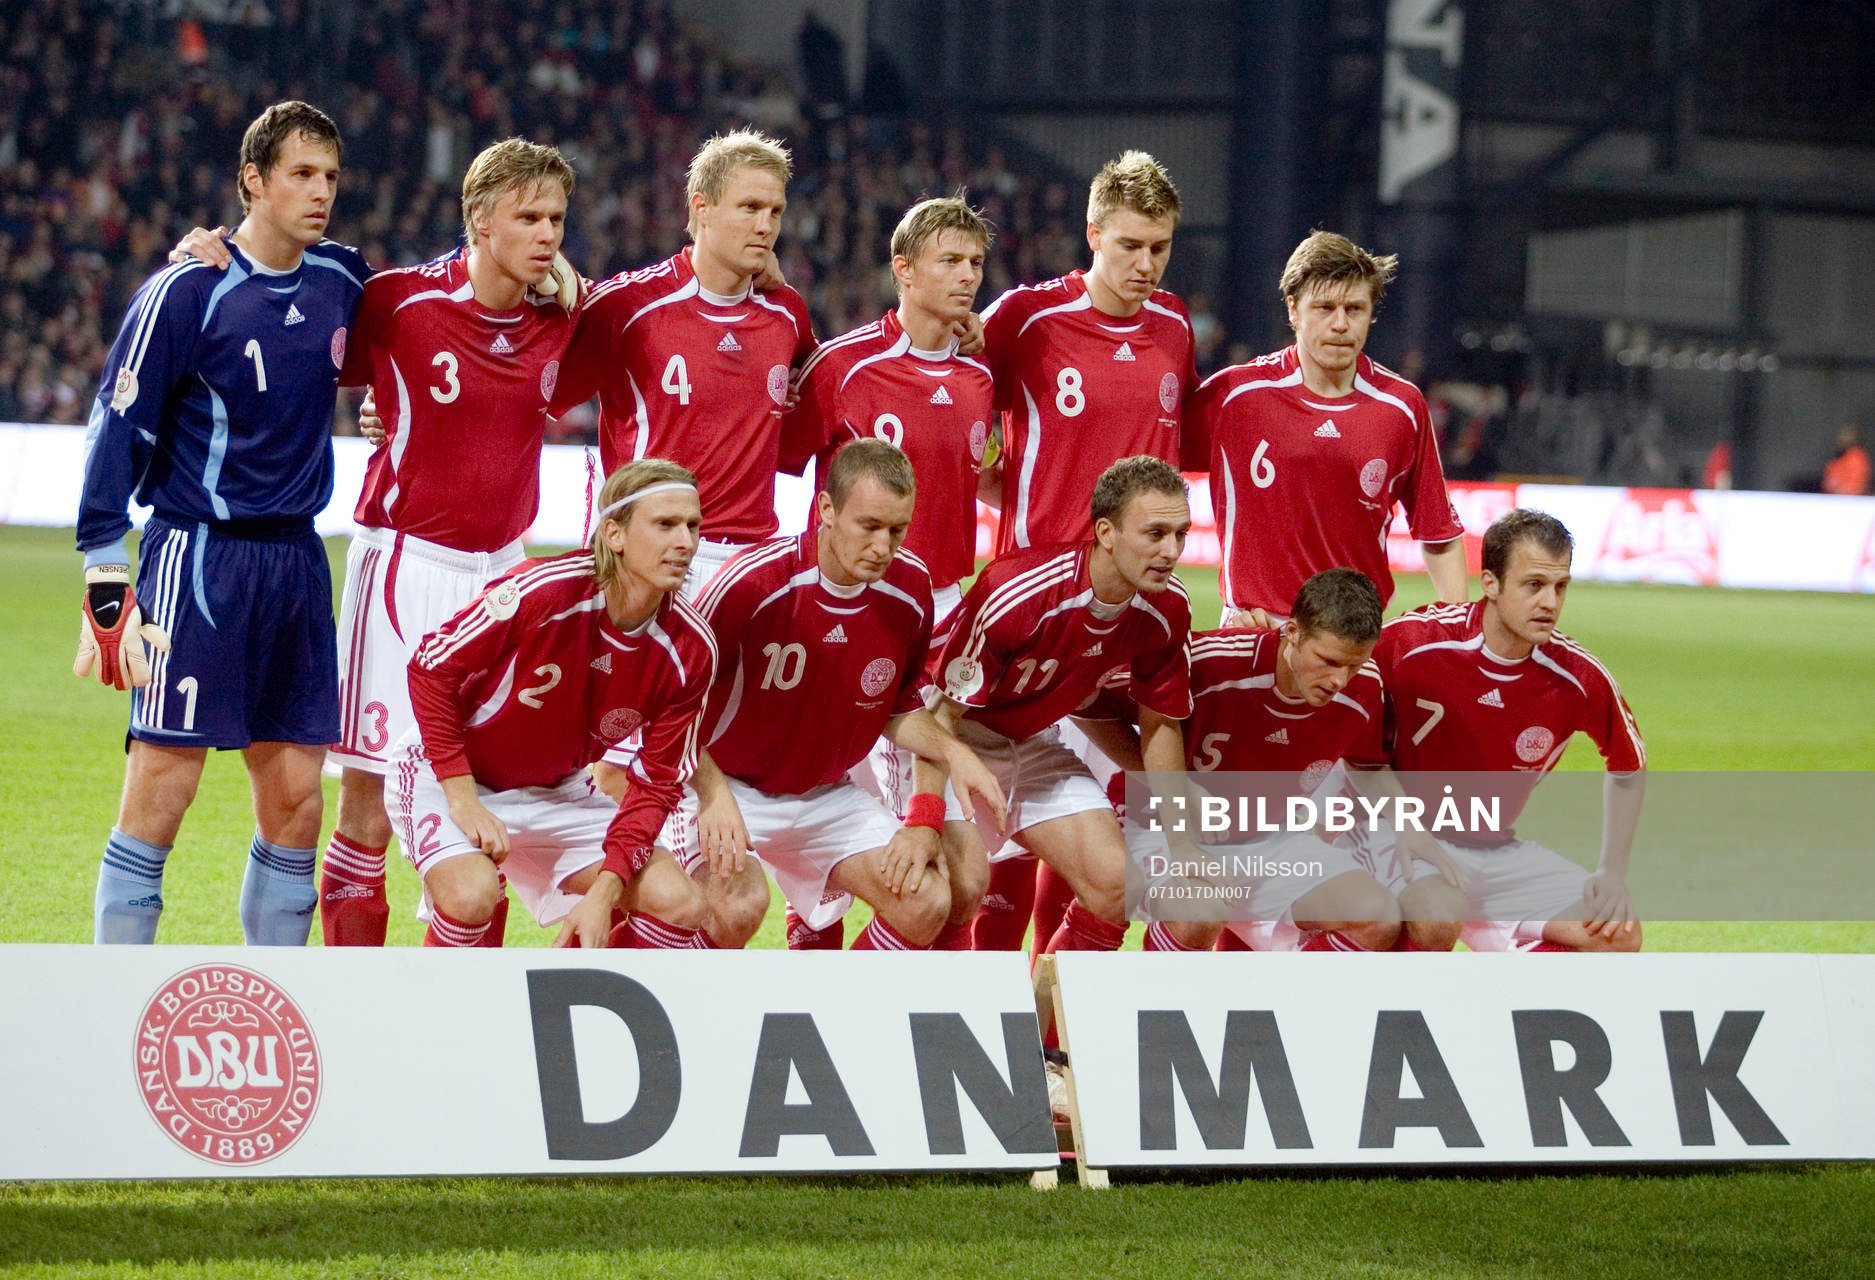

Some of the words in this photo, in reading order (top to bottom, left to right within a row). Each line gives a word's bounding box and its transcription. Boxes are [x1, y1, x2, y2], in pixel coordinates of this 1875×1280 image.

[244, 338, 267, 392] 1
[429, 351, 460, 404] 3
[661, 354, 692, 405] 4
[1055, 367, 1085, 417] 8
[873, 413, 904, 449] 9
[1250, 438, 1276, 489] 6
[517, 663, 562, 710] 2
[760, 642, 807, 691] 10
[1012, 658, 1060, 694] 11
[176, 676, 199, 730] 1
[362, 701, 389, 752] 3
[1411, 697, 1445, 747] 7
[1192, 732, 1231, 772] 5
[416, 812, 442, 856] 2
[325, 887, 374, 901] adidas
[172, 1030, 284, 1091] DBU
[141, 1020, 193, 1138] DANSK
[201, 1132, 275, 1160] 1889
